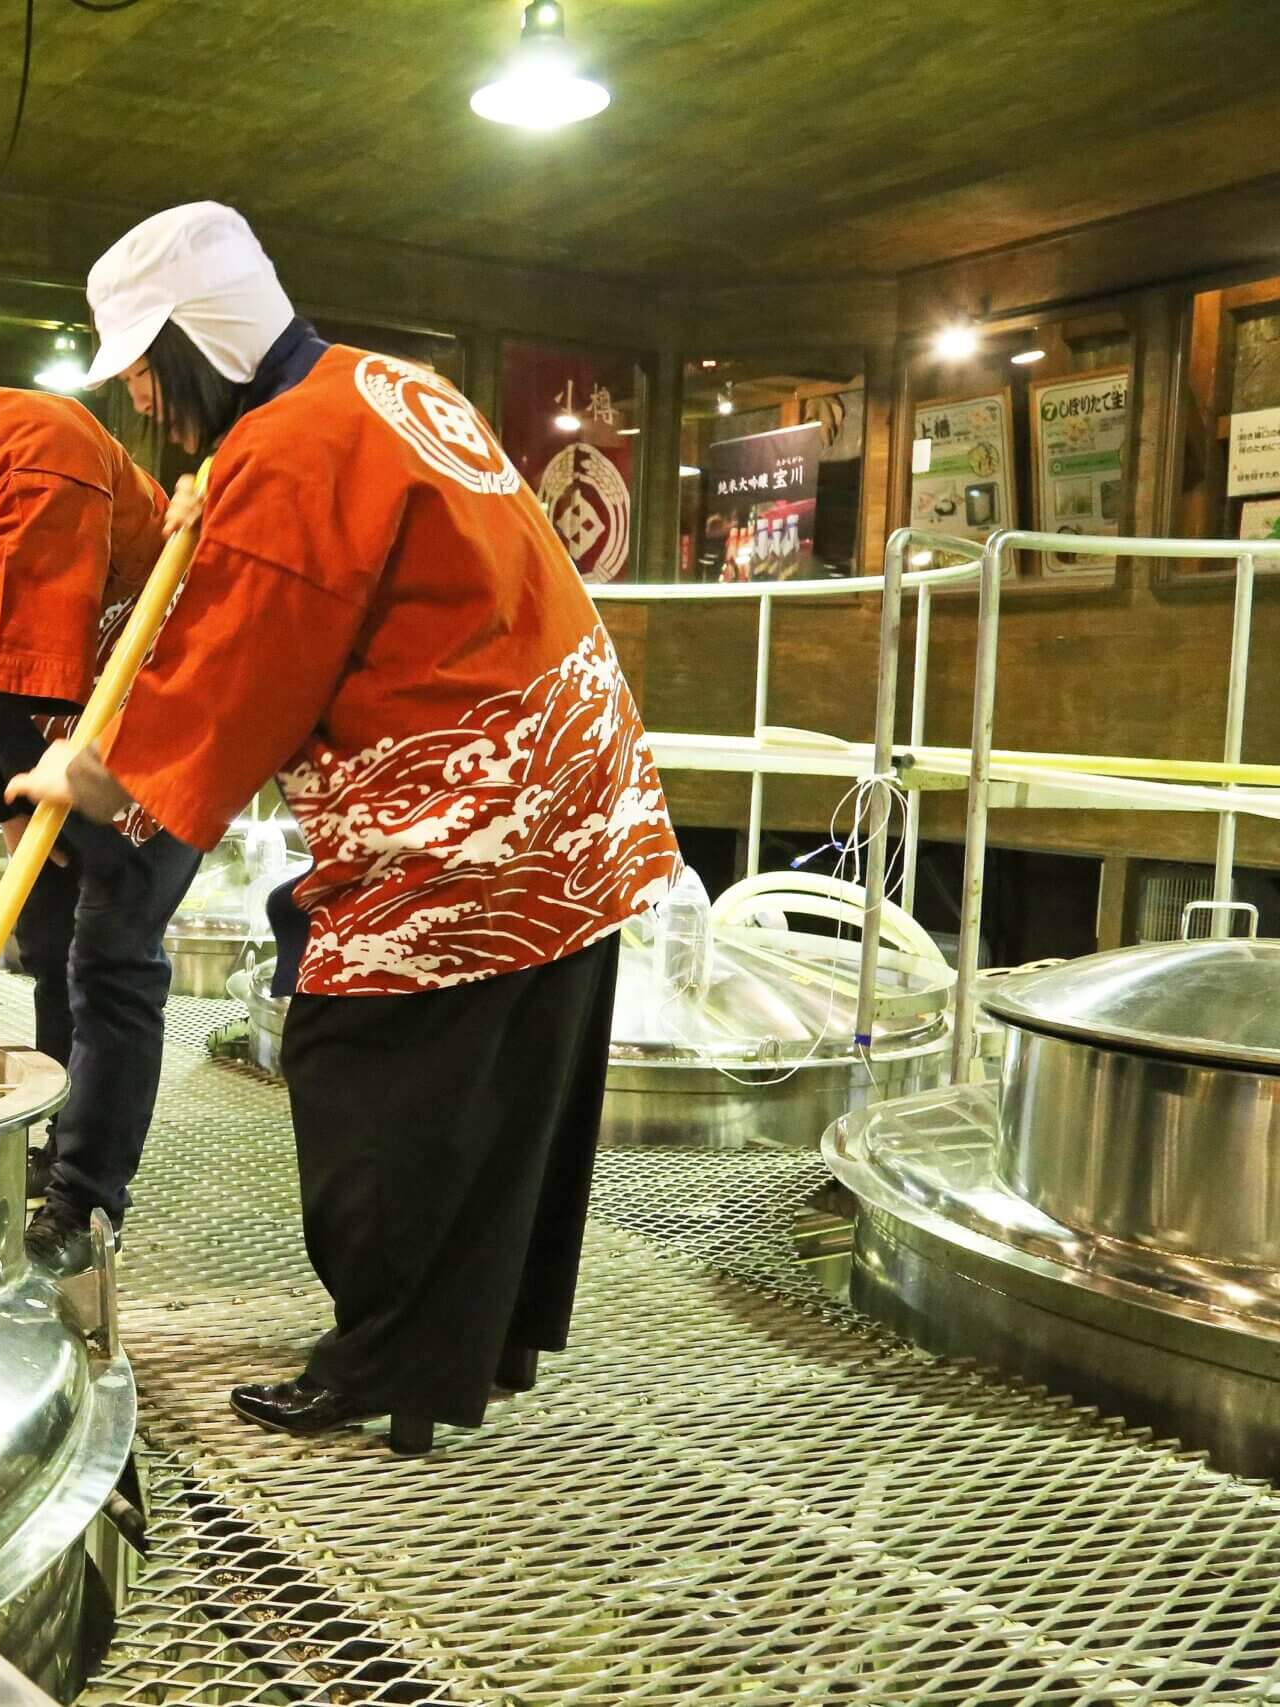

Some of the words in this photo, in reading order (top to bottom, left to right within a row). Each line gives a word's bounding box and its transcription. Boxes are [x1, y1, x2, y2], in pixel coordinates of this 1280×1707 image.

[1059, 389, 1127, 418] しぼりたて生
[718, 473, 768, 495] 純米大吟醸
[773, 465, 803, 489] 宝川
